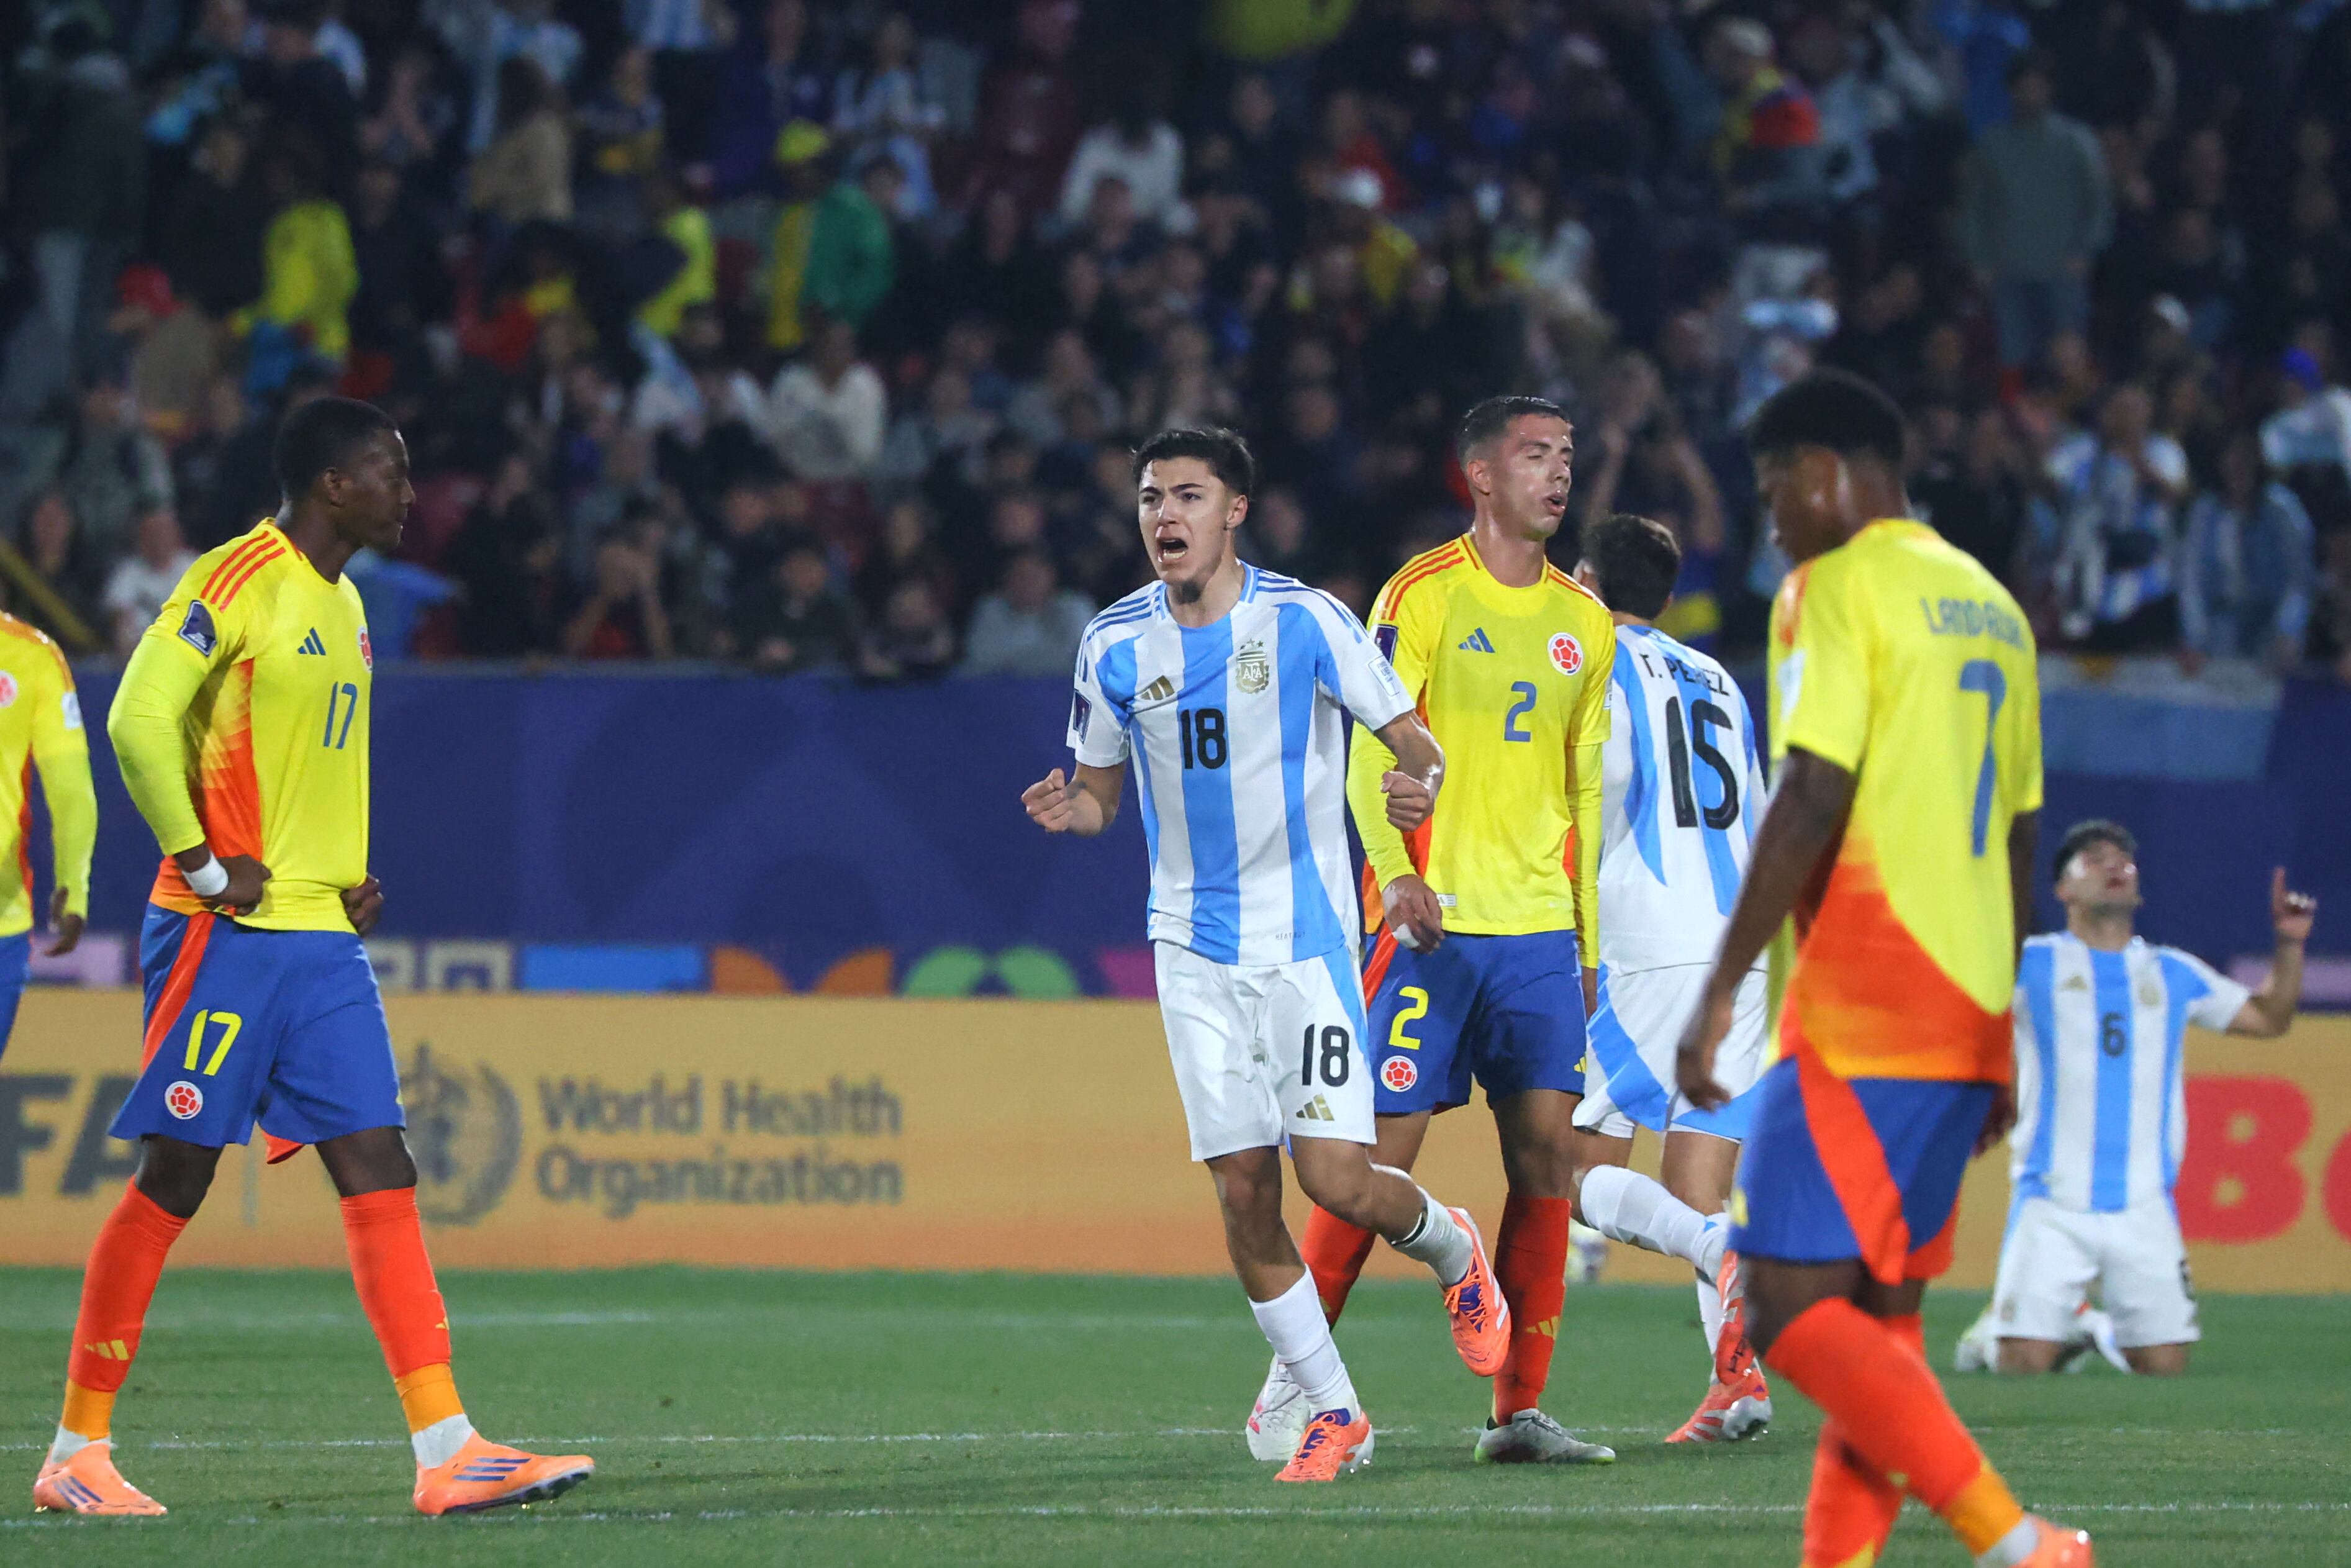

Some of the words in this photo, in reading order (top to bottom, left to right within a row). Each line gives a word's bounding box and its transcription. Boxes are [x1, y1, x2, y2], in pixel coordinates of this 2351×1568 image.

[1242, 662, 1264, 682] AFA
[1639, 653, 1663, 678] T.
[1663, 657, 1729, 696] PEEZ
[323, 681, 358, 750] 17
[1180, 707, 1228, 770] 18
[1504, 681, 1537, 743] 2
[1665, 696, 1739, 830] 15
[1959, 658, 2008, 858] 7
[183, 1009, 242, 1076] 17
[1388, 986, 1429, 1051] 2
[2102, 1012, 2126, 1058] 6
[1302, 1023, 1350, 1087] 18
[537, 1073, 703, 1134] World
[722, 1074, 903, 1136] Health
[536, 1141, 903, 1220] Organization
[2175, 1075, 2351, 1244] B
